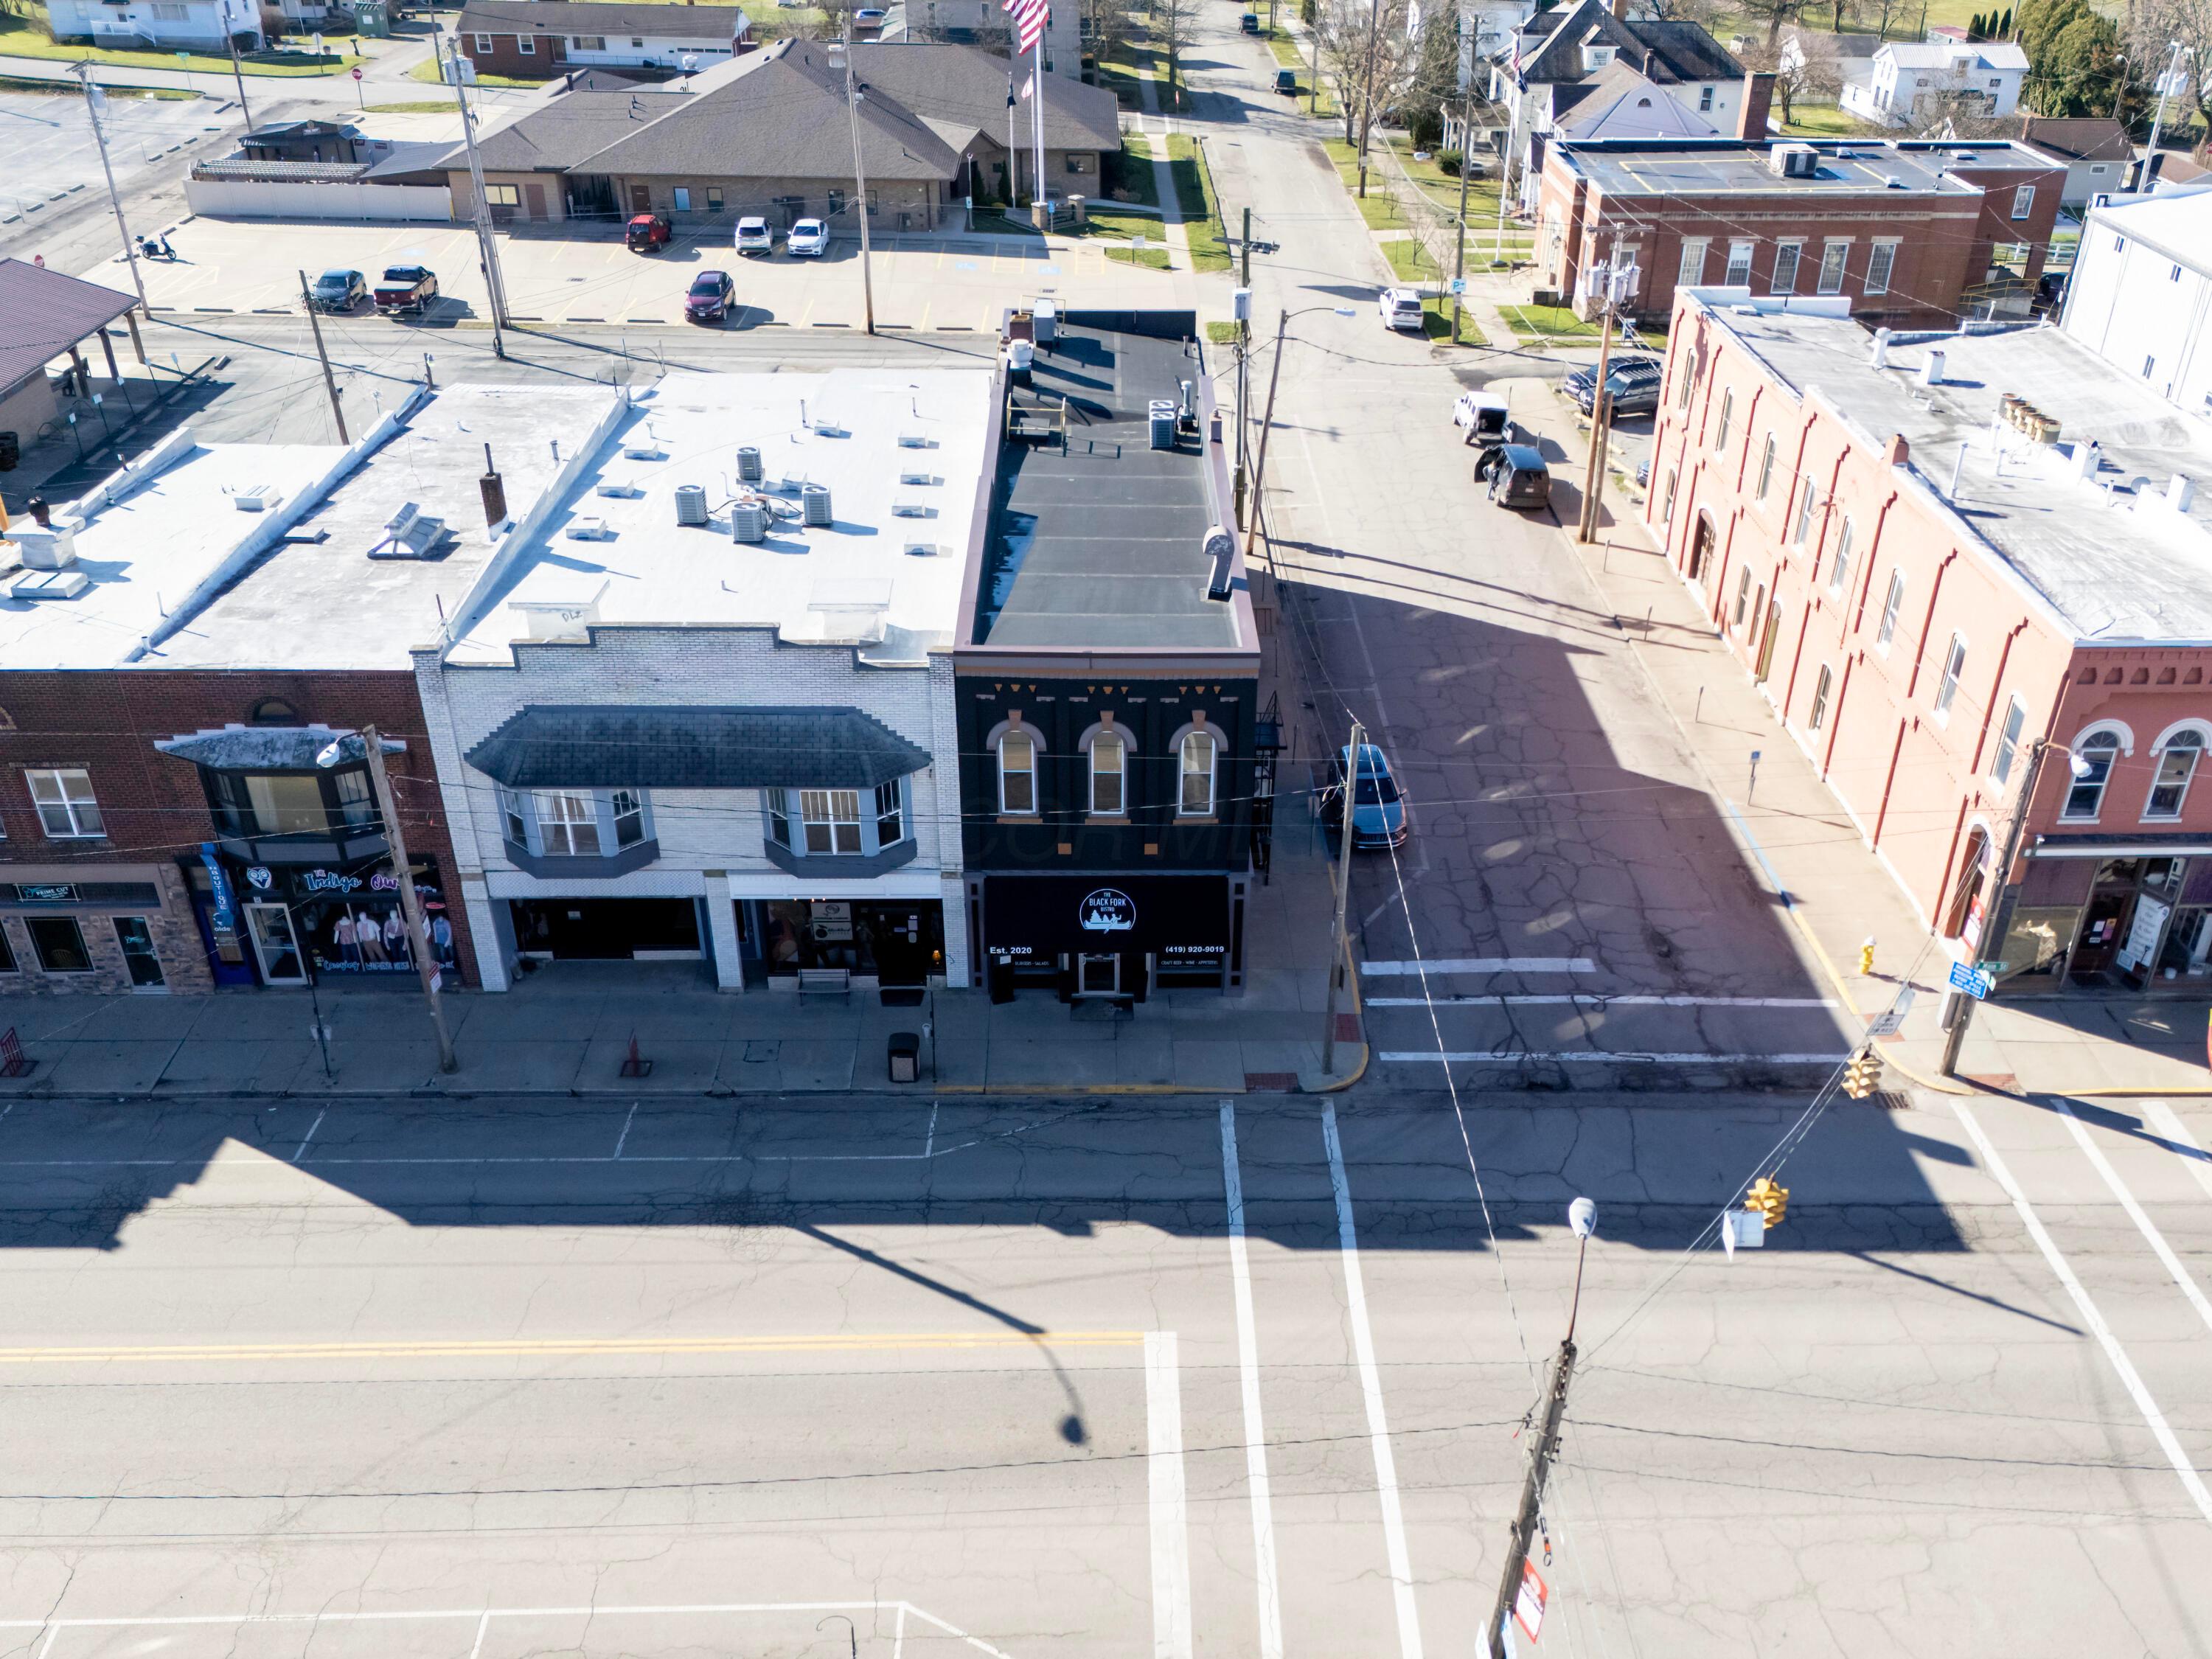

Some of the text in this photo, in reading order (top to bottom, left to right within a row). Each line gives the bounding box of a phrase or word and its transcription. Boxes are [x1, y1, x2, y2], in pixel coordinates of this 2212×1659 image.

[305, 872, 362, 892] Indigo
[371, 874, 399, 890] Ow
[1089, 898, 1127, 906] BLACK FORK
